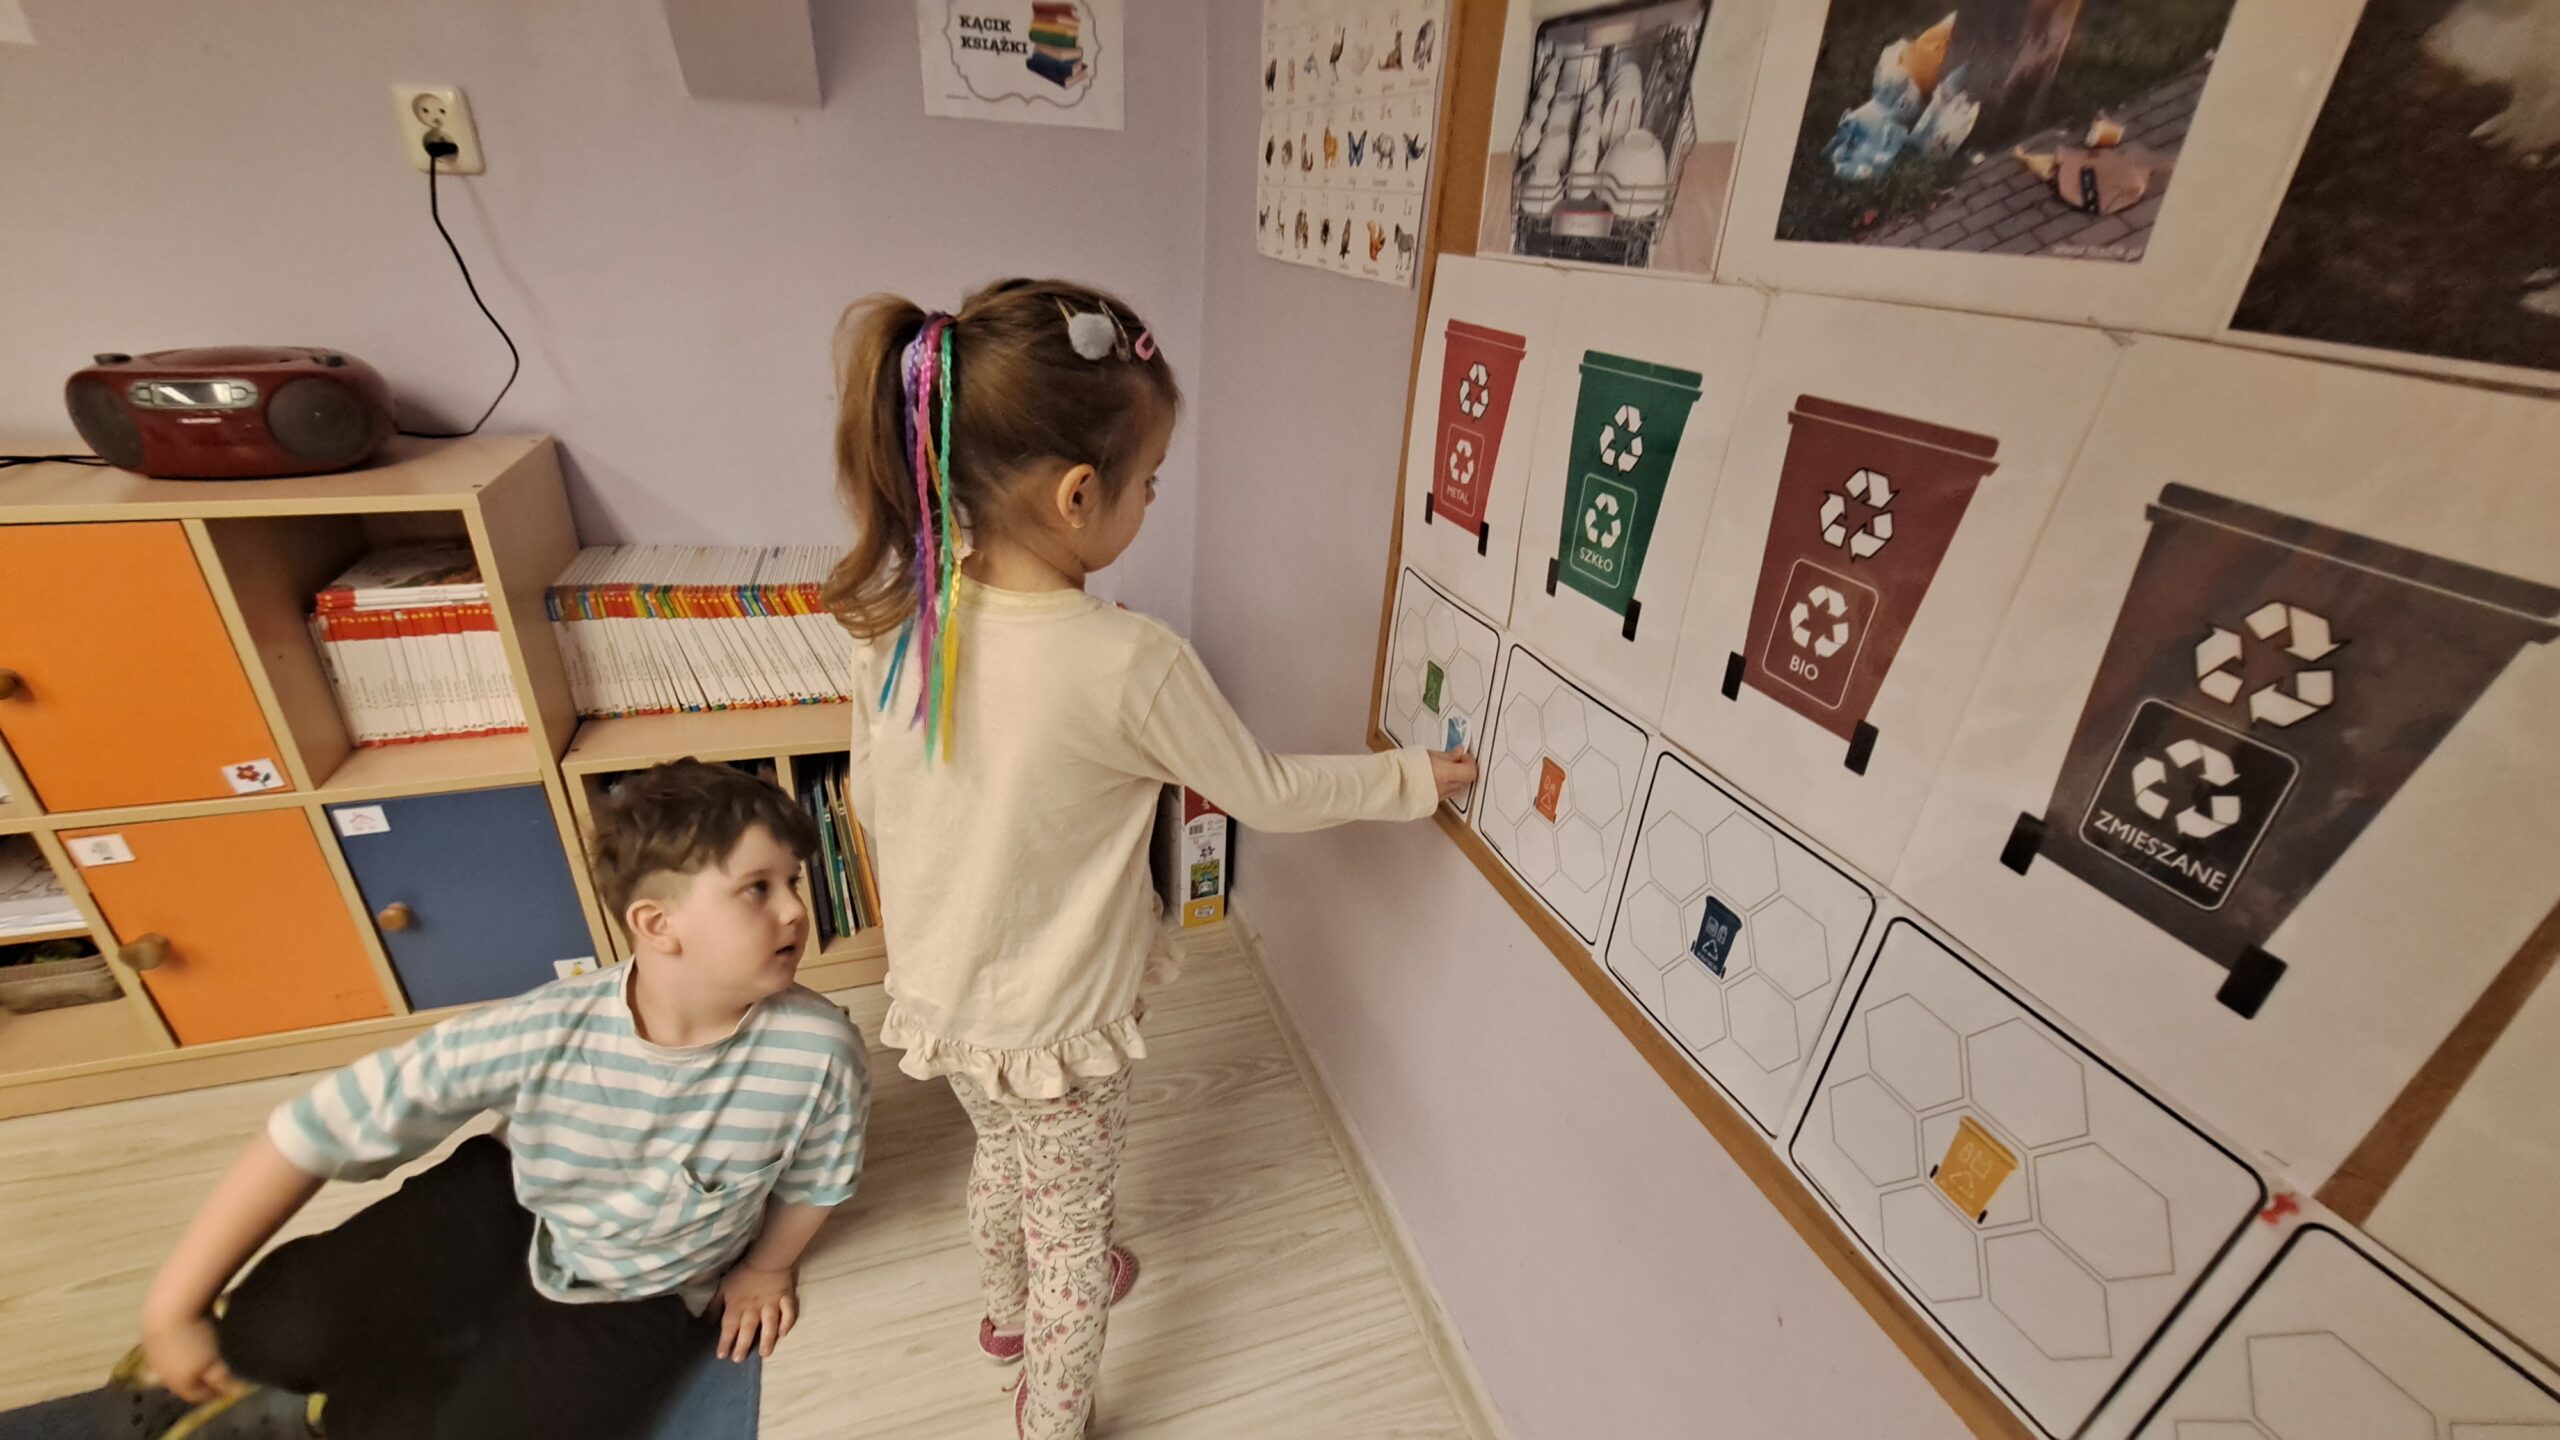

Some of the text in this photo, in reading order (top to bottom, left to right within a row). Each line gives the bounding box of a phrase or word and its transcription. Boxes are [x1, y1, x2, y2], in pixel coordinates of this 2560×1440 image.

[959, 15, 1012, 34] KĄCIK
[961, 36, 1028, 56] KSIĄŻKI
[1446, 484, 1469, 505] METAL
[1579, 547, 1613, 572] SZKŁO
[1789, 654, 1819, 681] BIO
[2094, 809, 2227, 892] ZMIESZANE
